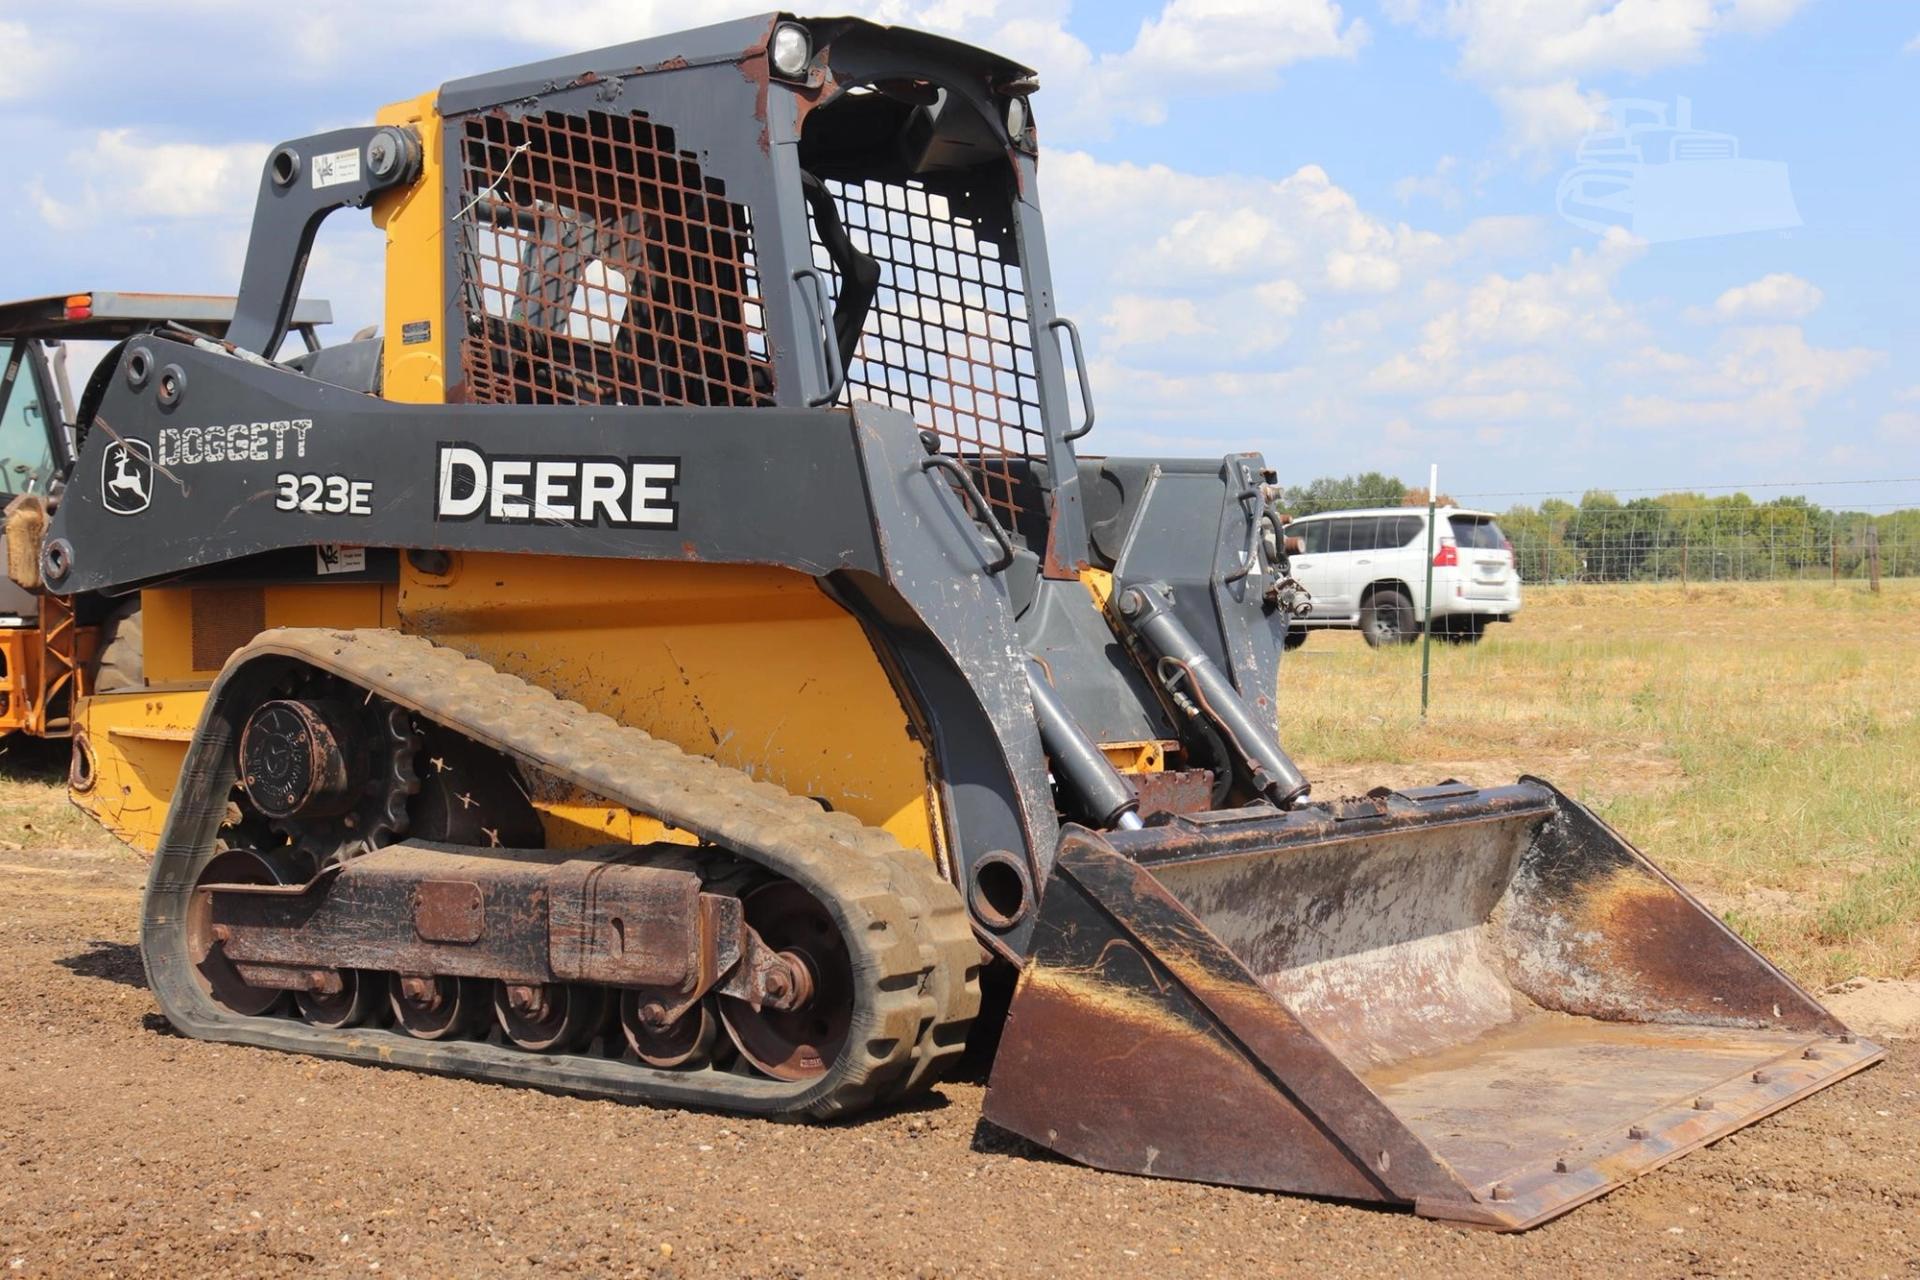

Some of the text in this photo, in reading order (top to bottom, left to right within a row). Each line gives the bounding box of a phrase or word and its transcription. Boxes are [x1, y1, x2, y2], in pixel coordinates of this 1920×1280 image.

[159, 419, 313, 465] DOGGETT
[275, 473, 373, 515] 323E
[439, 448, 676, 523] DEERE
